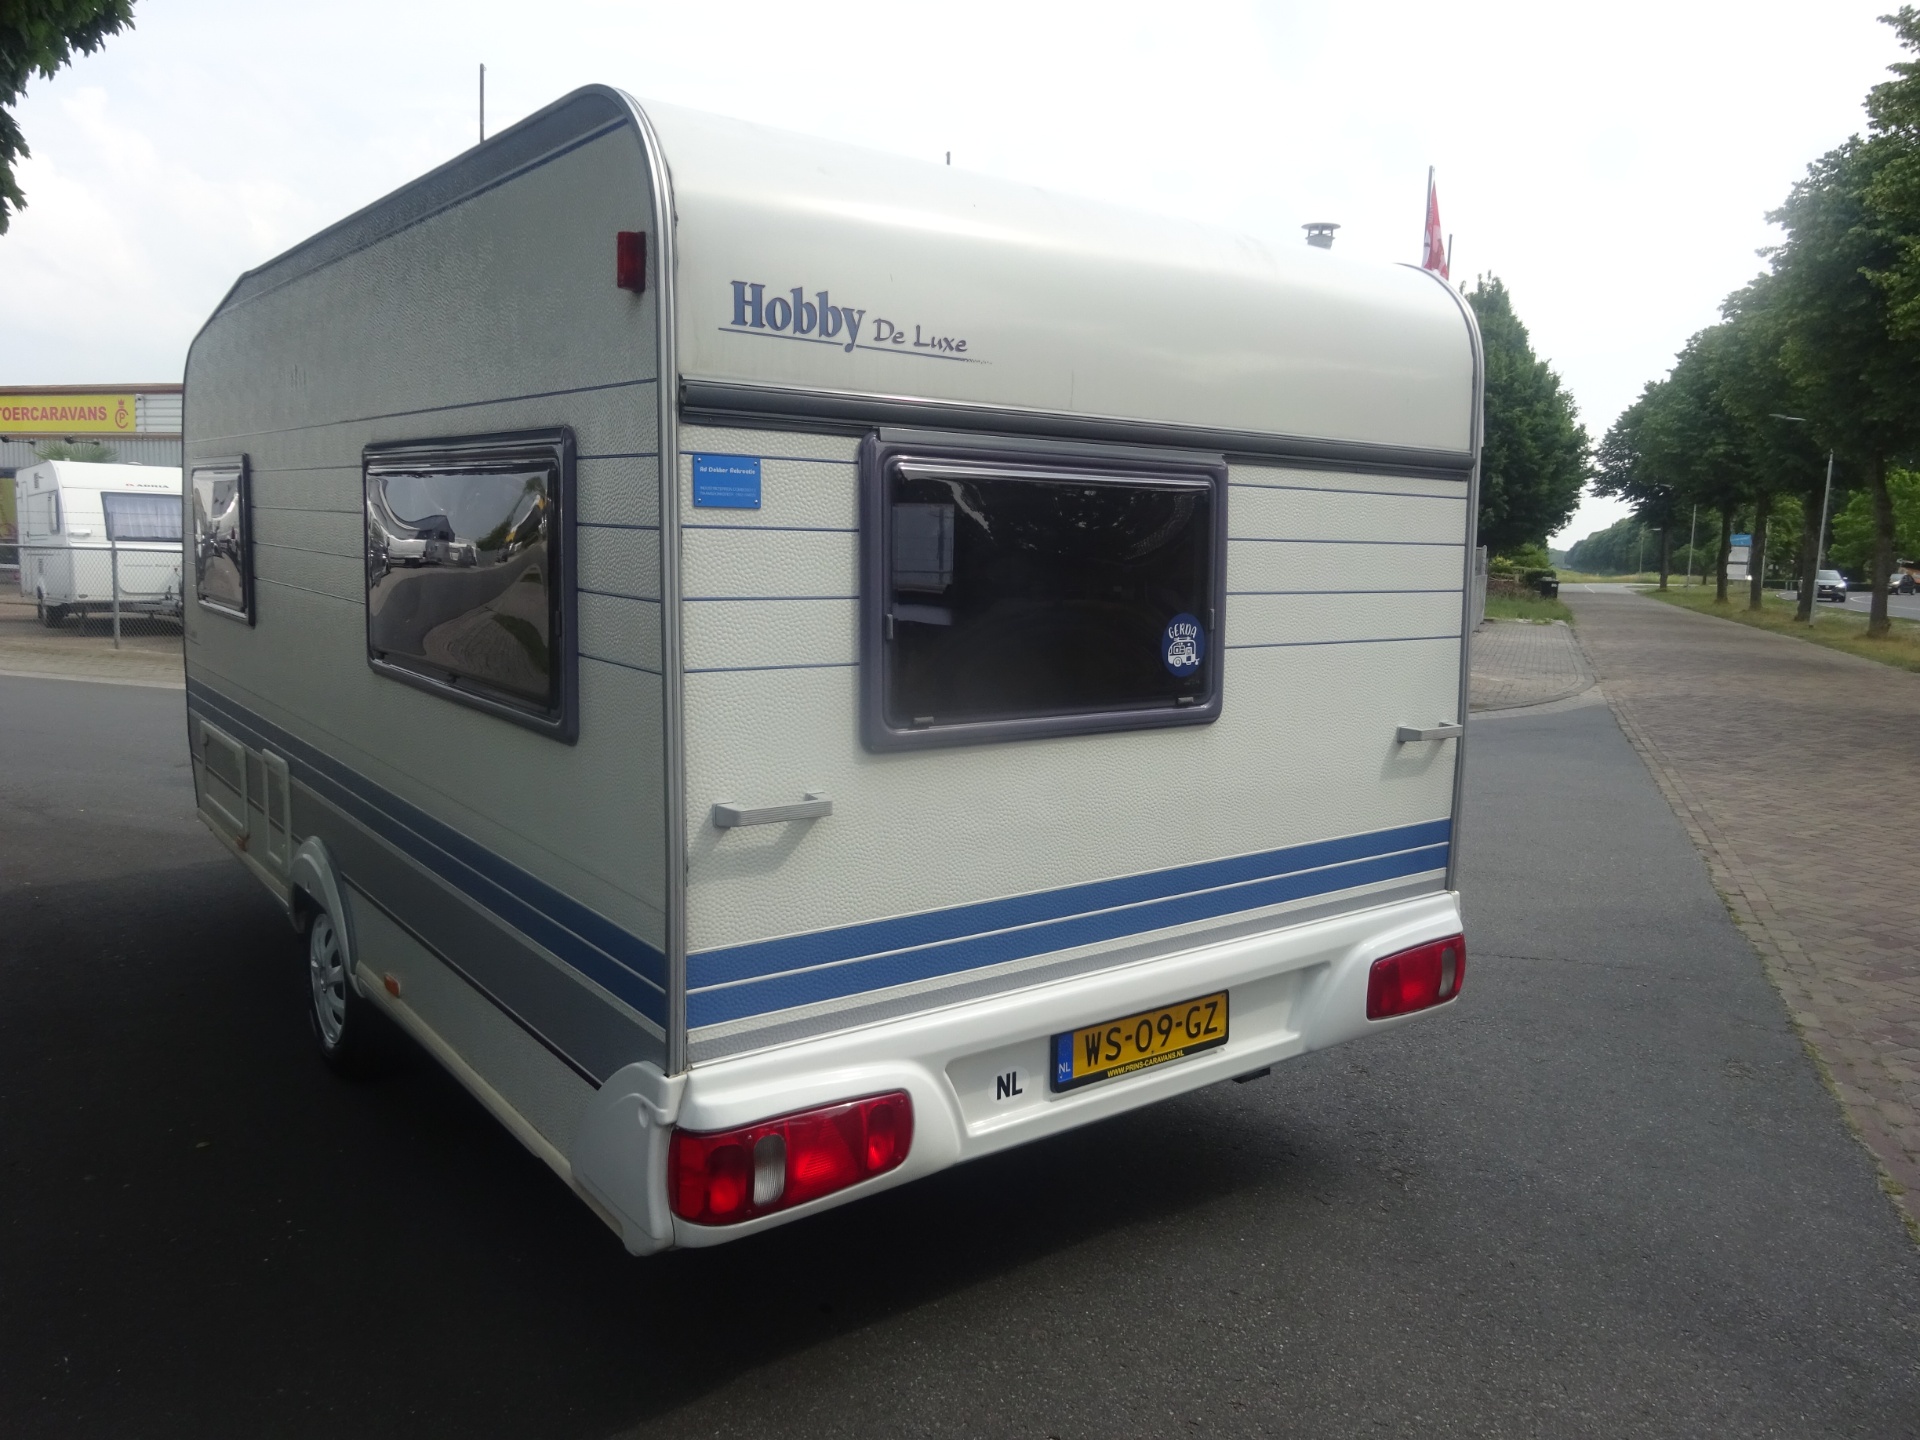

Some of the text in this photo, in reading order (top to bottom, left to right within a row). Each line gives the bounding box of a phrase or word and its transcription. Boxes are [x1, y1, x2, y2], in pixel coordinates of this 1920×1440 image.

[730, 280, 968, 353] Hobby De Luxe
[0, 406, 107, 421] OERCARAVANS
[1168, 622, 1197, 639] GERDA
[1085, 1000, 1219, 1067] WS-09-GZ
[1058, 1062, 1071, 1074] NL
[1107, 1049, 1185, 1078] WWW.PRINS-CARAVANS.NL
[996, 1071, 1023, 1100] NL
